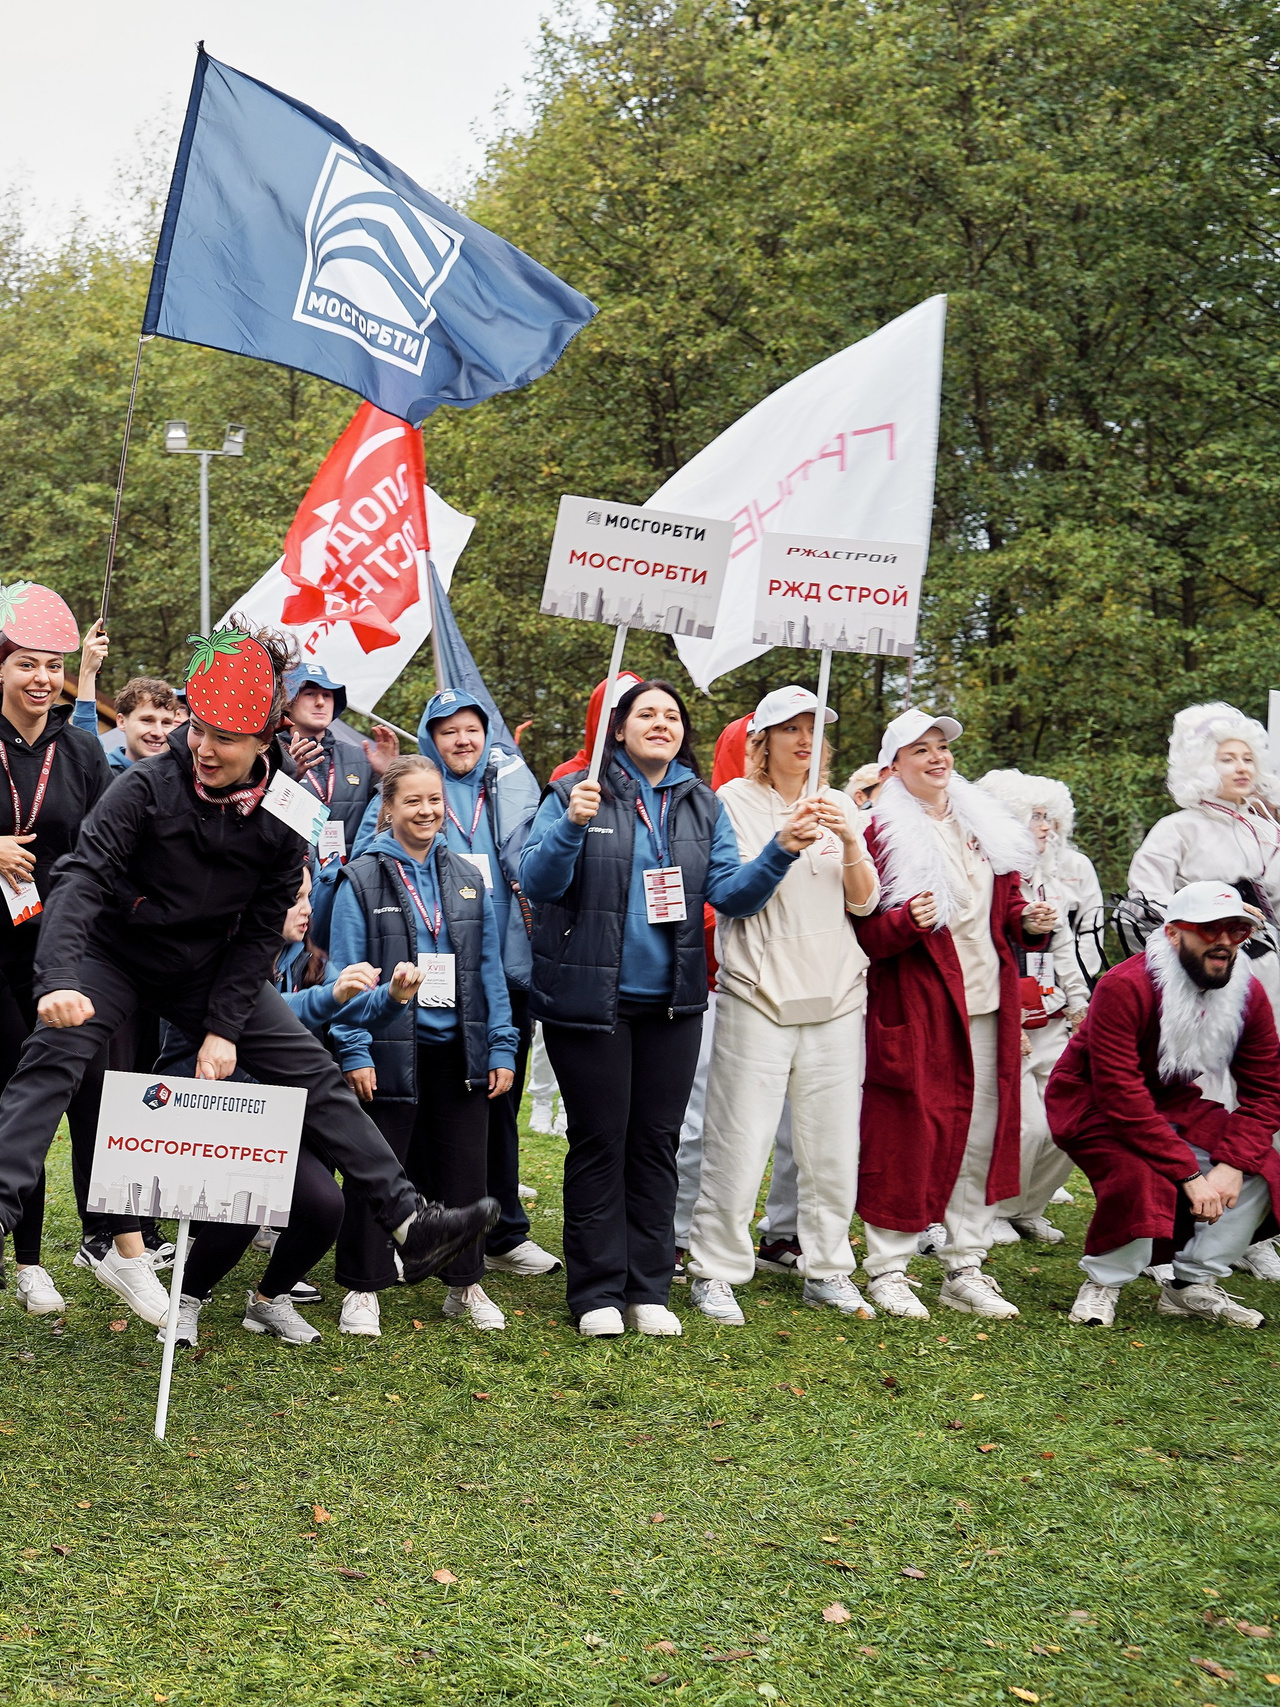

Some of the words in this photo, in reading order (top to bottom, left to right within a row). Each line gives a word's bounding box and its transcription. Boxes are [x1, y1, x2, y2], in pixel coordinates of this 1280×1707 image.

[307, 291, 420, 359] МОСГОРБТИ
[605, 514, 706, 541] МОСГОРБТИ
[568, 549, 708, 585] МОСГОРБТИ
[787, 547, 898, 564] РЖДСТРОЙ
[768, 579, 821, 603] РЖД
[828, 584, 908, 607] СТРОЙ
[173, 1092, 266, 1115] МОСГОРГЕОТРЕСТ
[107, 1135, 288, 1163] МОСГОРГЕОТРЕСТ
